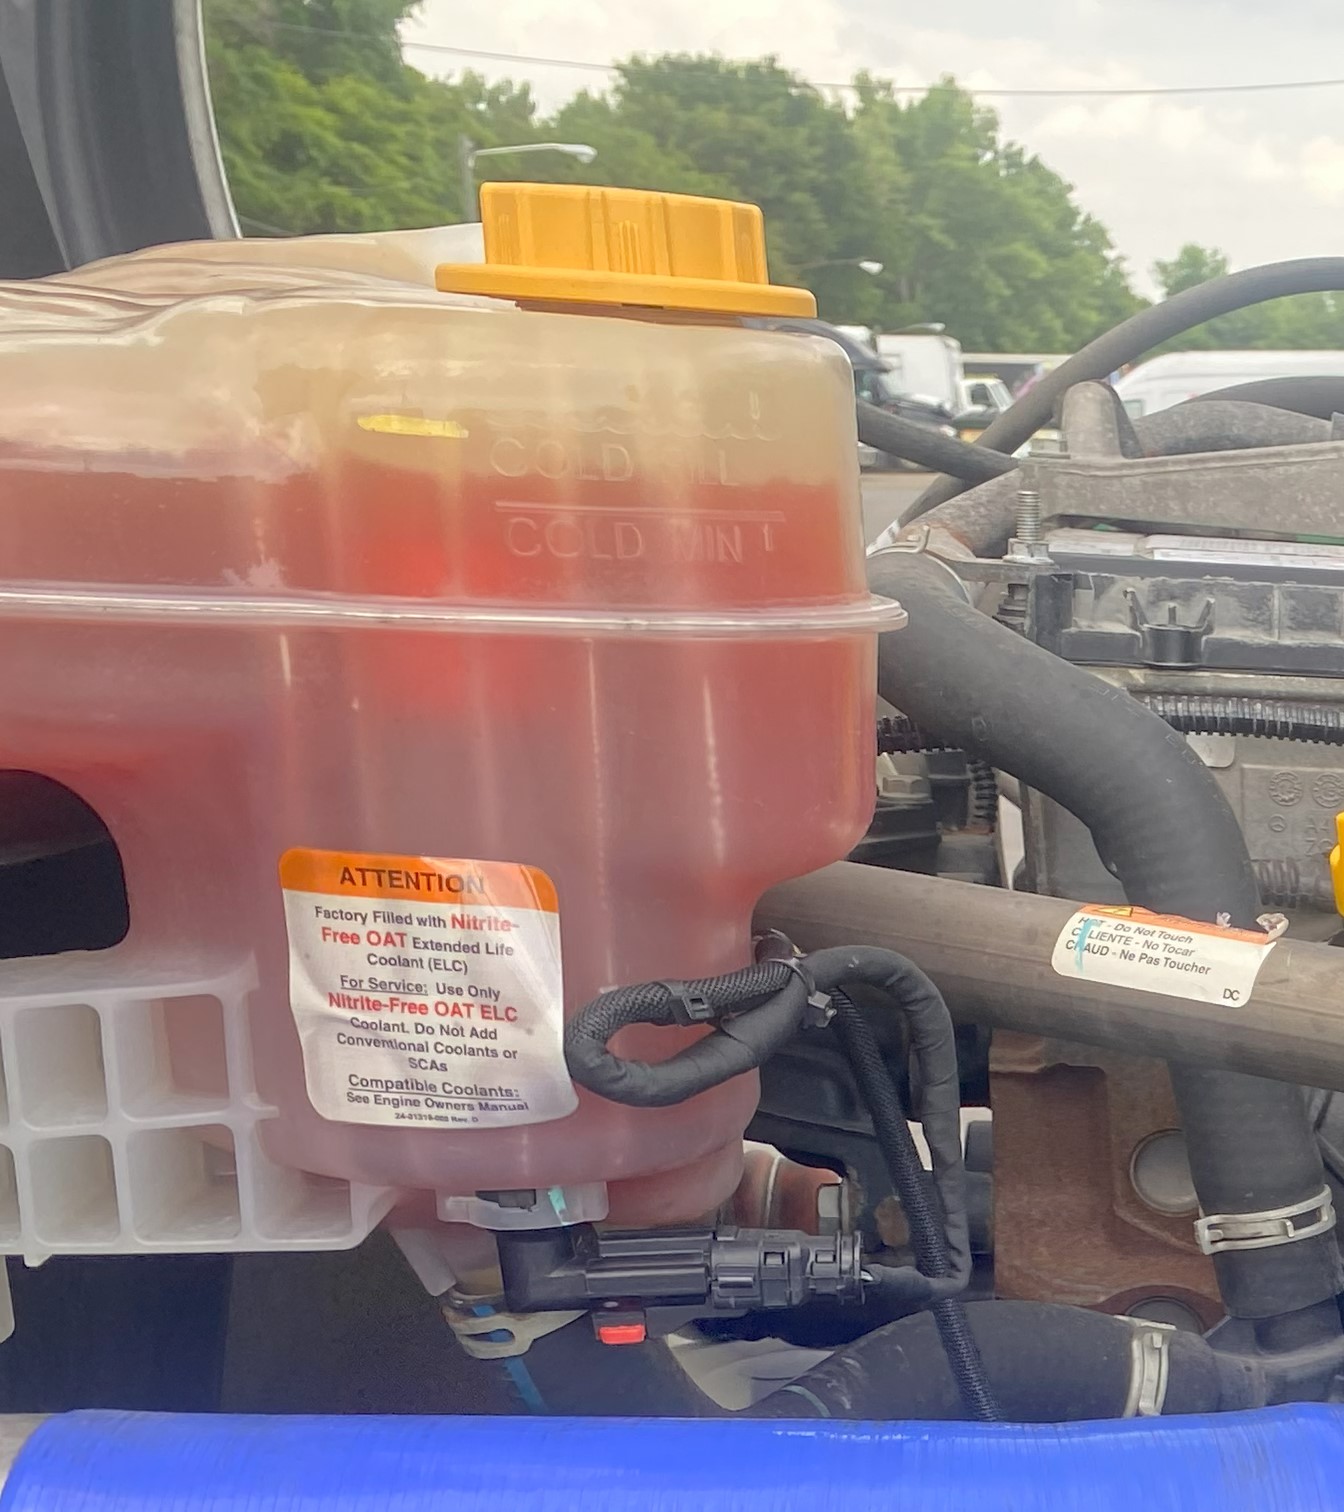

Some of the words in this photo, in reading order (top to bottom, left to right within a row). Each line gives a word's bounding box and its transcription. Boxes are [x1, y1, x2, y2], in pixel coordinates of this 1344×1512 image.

[507, 517, 644, 560] COLD
[340, 866, 485, 894] ATTENTION
[315, 905, 368, 926] Factory
[373, 912, 413, 926] Filled
[416, 915, 447, 929] with
[450, 913, 521, 933] Nitrite-
[321, 927, 361, 945] Free
[366, 931, 407, 949] OAT
[412, 938, 481, 955] Extended
[485, 943, 514, 957] Life
[1071, 927, 1132, 946] CLIENTE
[1142, 940, 1159, 951] No
[1162, 944, 1195, 957] Tocar
[1114, 923, 1132, 932] Do
[1135, 926, 1156, 936] Not
[1158, 931, 1194, 944] Touch
[367, 953, 424, 970] Coolant
[428, 958, 468, 975] (ELC)
[1119, 949, 1136, 961] Ne
[1138, 953, 1160, 966] Pas
[1163, 957, 1211, 975] Toucher
[340, 975, 364, 990] For
[368, 978, 428, 994] Service:
[436, 982, 464, 997] Use
[468, 985, 501, 1002] Only
[1222, 988, 1240, 1001] DC
[328, 992, 429, 1015] Nitrite-Free
[434, 1002, 475, 1019] OAT
[480, 1005, 519, 1023] ELC
[350, 1017, 410, 1034] Coolant.
[415, 1022, 435, 1035] Do
[440, 1025, 465, 1038] Not
[470, 1027, 498, 1040] Add
[337, 1033, 429, 1053] Conventional
[433, 1040, 499, 1059] Coolants
[503, 1049, 518, 1060] or
[408, 1057, 448, 1072] SCAs
[348, 1074, 438, 1095] Compatible
[442, 1083, 521, 1098] Coolants:
[347, 1092, 370, 1104] See
[374, 1094, 421, 1110] Engine
[424, 1097, 475, 1111] Owners
[478, 1101, 529, 1112] Manual
